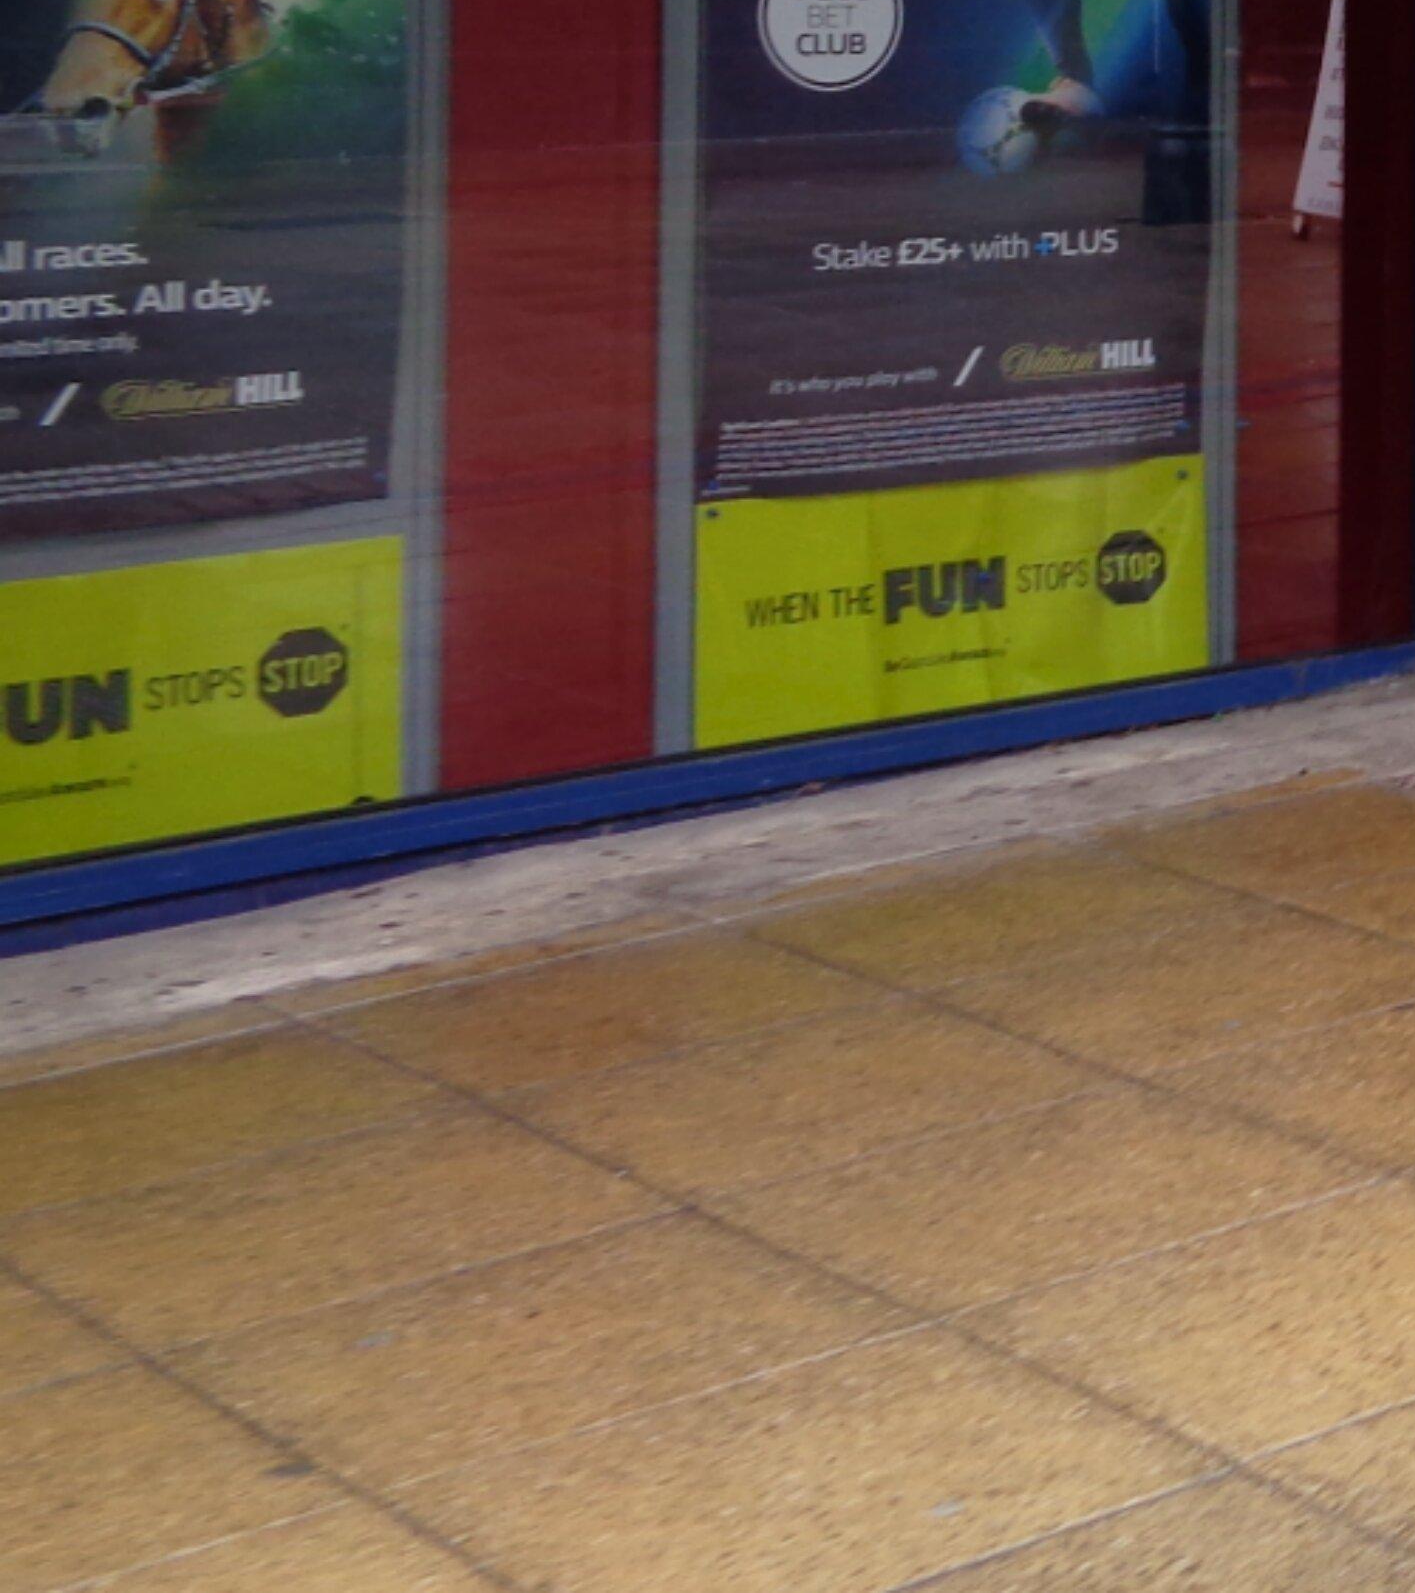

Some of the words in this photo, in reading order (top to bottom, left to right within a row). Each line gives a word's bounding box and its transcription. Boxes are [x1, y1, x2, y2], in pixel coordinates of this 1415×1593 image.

[807, 4, 857, 29] BET
[795, 33, 867, 55] CLUB
[34, 242, 148, 271] races.
[812, 241, 891, 270] Stake
[970, 235, 1029, 261] with
[133, 281, 185, 314] All
[193, 279, 273, 314] day.
[1100, 337, 1156, 371] HILL
[235, 370, 304, 406] HILL
[744, 591, 821, 628] WHEN
[829, 583, 876, 618] THE
[882, 556, 1008, 625] FUN
[1015, 558, 1088, 594] STOPS
[1099, 552, 1161, 585] STOP
[143, 665, 247, 711] STOPS
[261, 652, 344, 694] STOP
